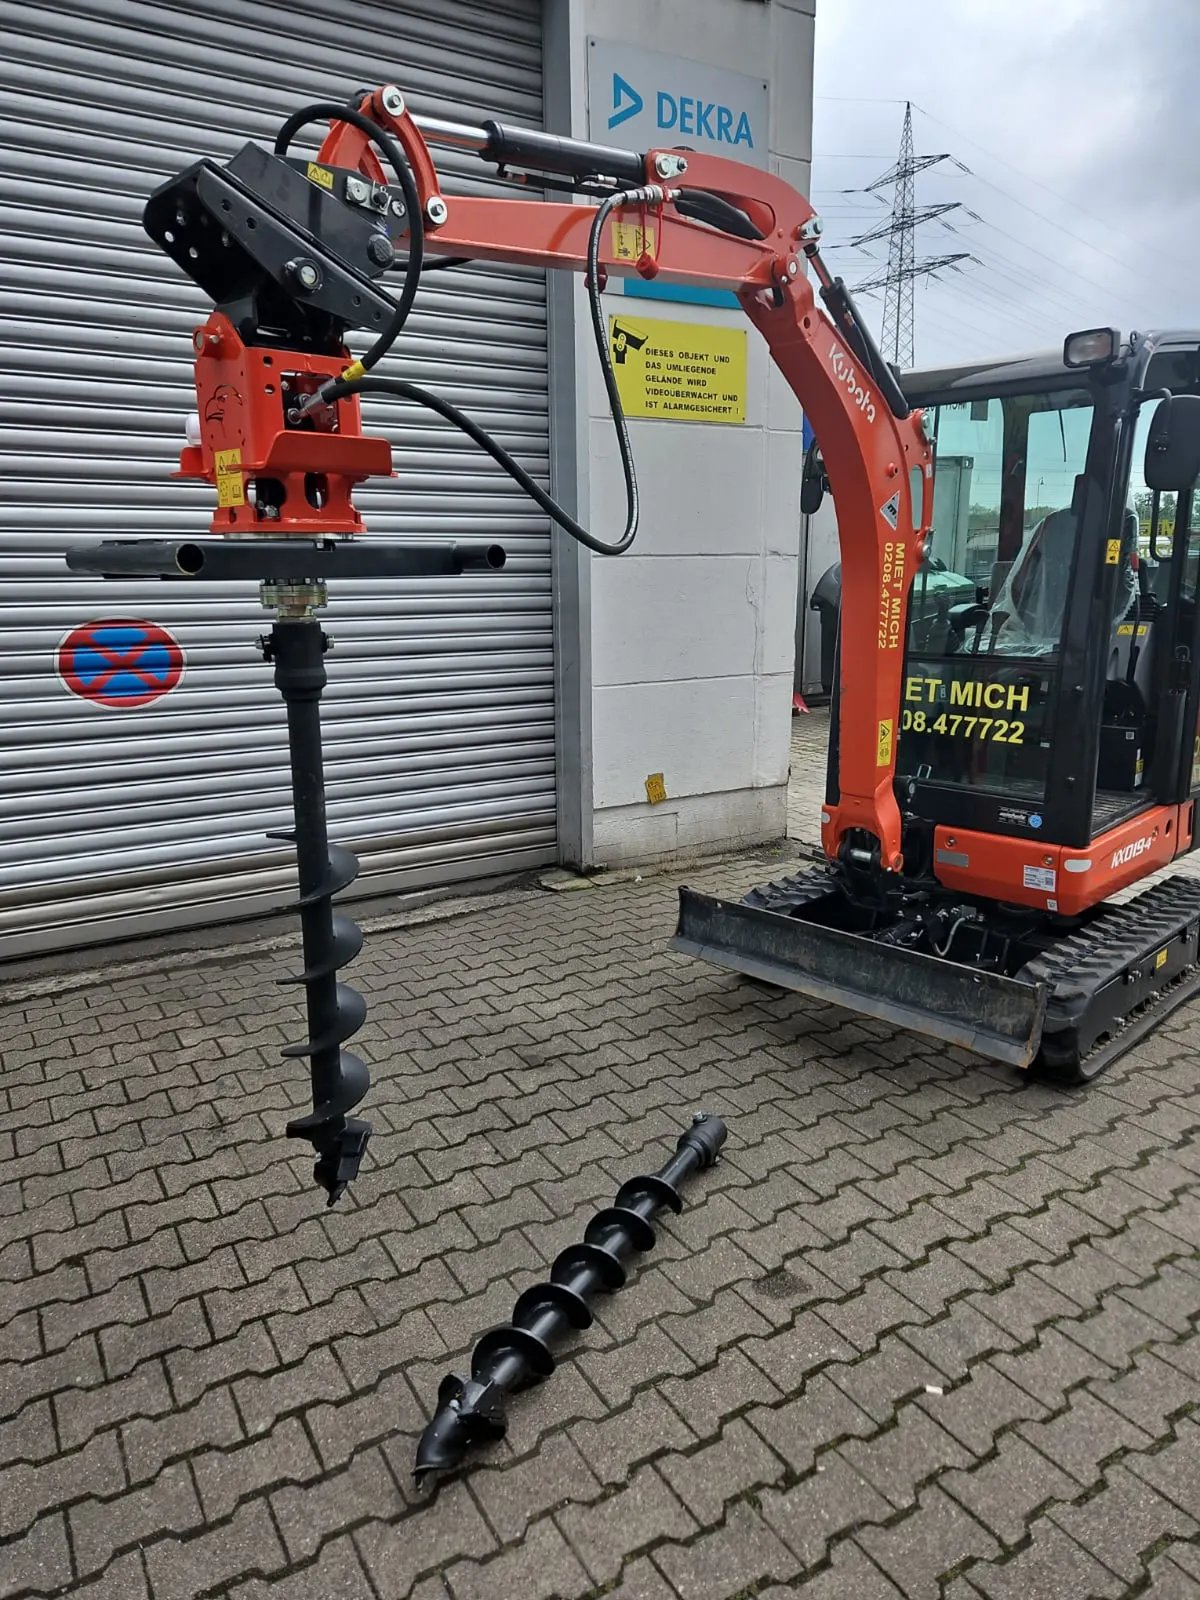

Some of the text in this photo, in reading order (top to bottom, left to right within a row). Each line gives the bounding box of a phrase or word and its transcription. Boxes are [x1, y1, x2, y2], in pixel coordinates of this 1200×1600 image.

[656, 90, 754, 149] DEKRA
[645, 348, 730, 364] DIESES OBJEKT UND
[645, 361, 717, 375] DAS UMLIEGENDE
[687, 378, 707, 387] WIRD
[828, 342, 876, 424] Kubota
[645, 400, 658, 409] IST
[663, 402, 732, 414] ALARMGESICHERT
[722, 394, 738, 402] UND
[878, 542, 894, 649] 0208.477722
[889, 542, 906, 649] MIET MICH
[949, 680, 1030, 712] MICH
